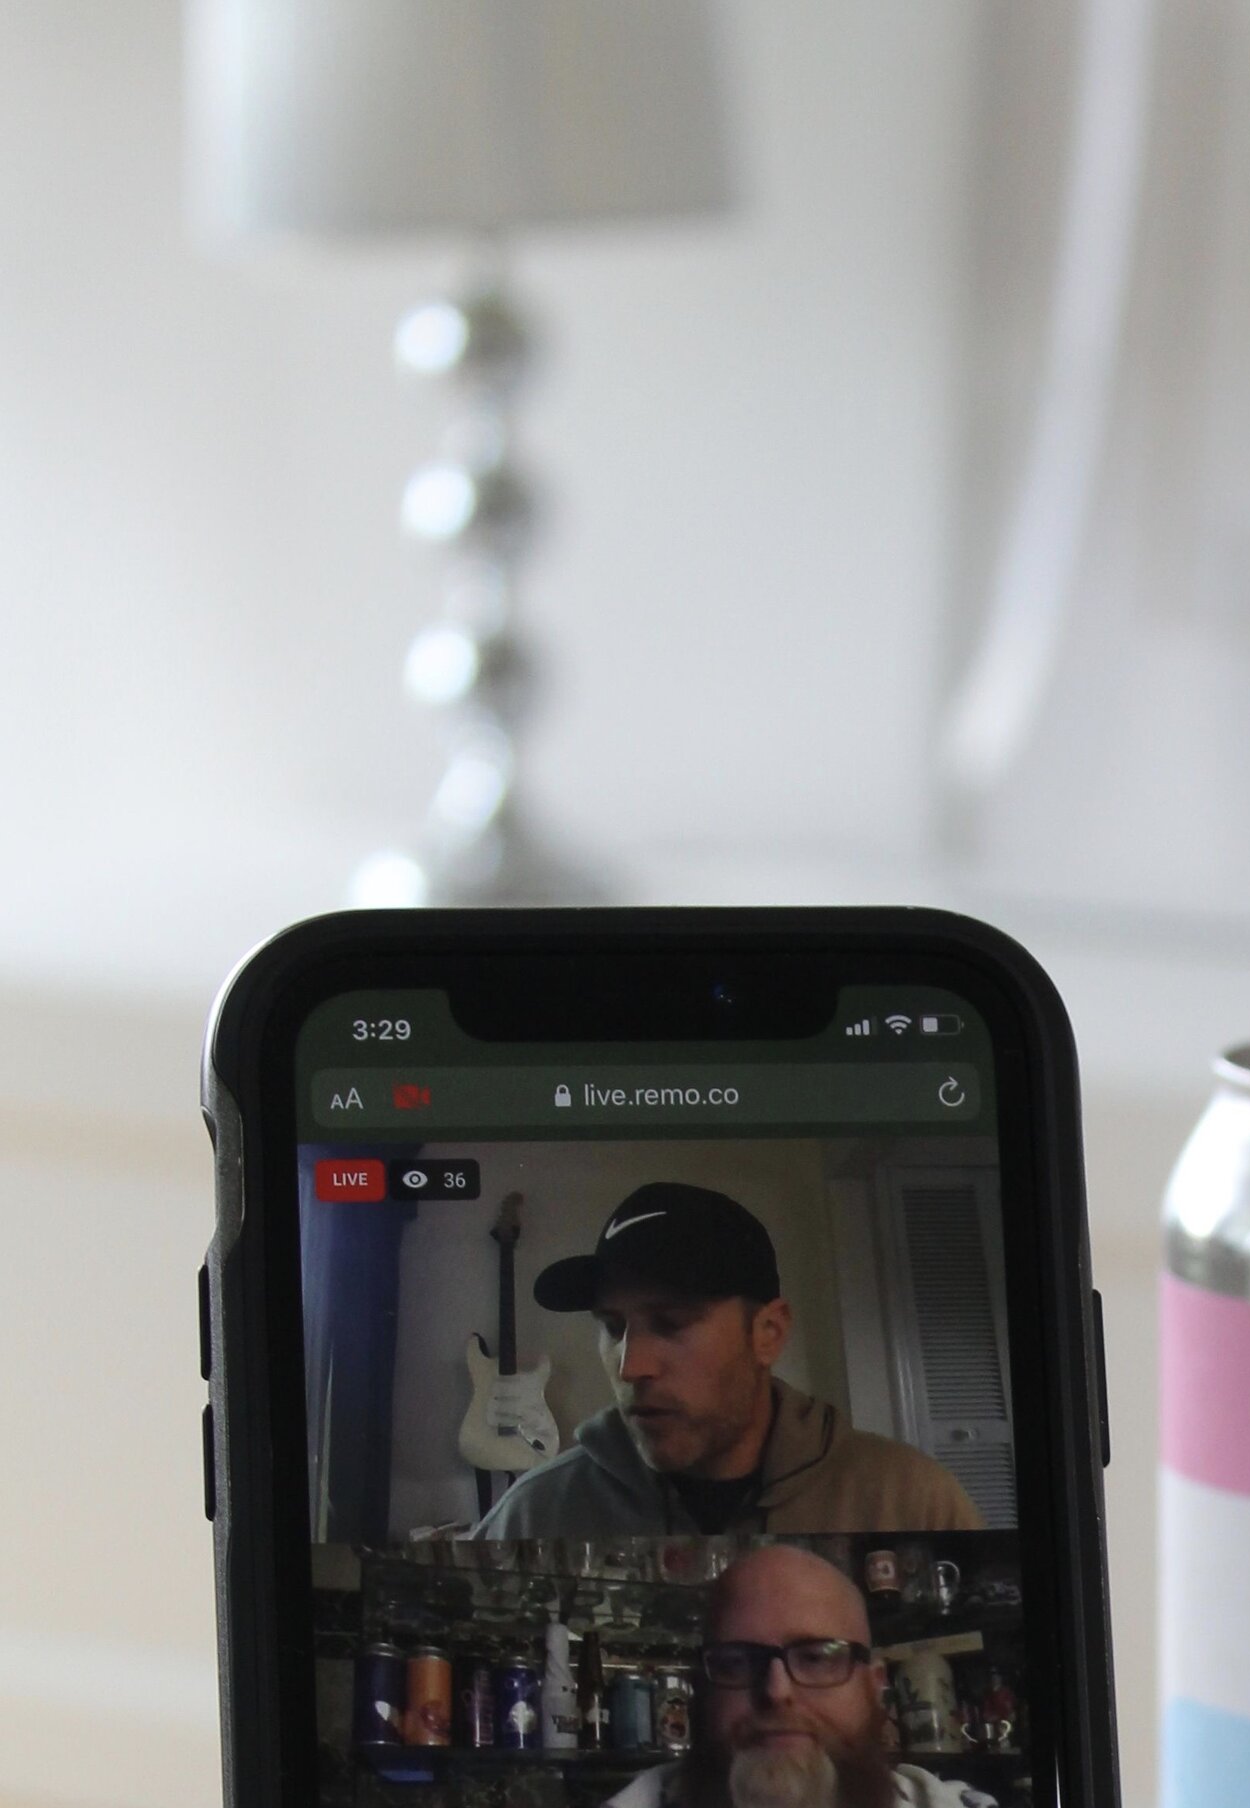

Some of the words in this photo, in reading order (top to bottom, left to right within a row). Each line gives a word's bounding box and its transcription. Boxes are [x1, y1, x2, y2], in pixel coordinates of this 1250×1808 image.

[352, 1019, 411, 1041] 3:29
[583, 1083, 739, 1107] live.remo.co
[332, 1171, 368, 1188] LIVE
[443, 1172, 466, 1189] 36
